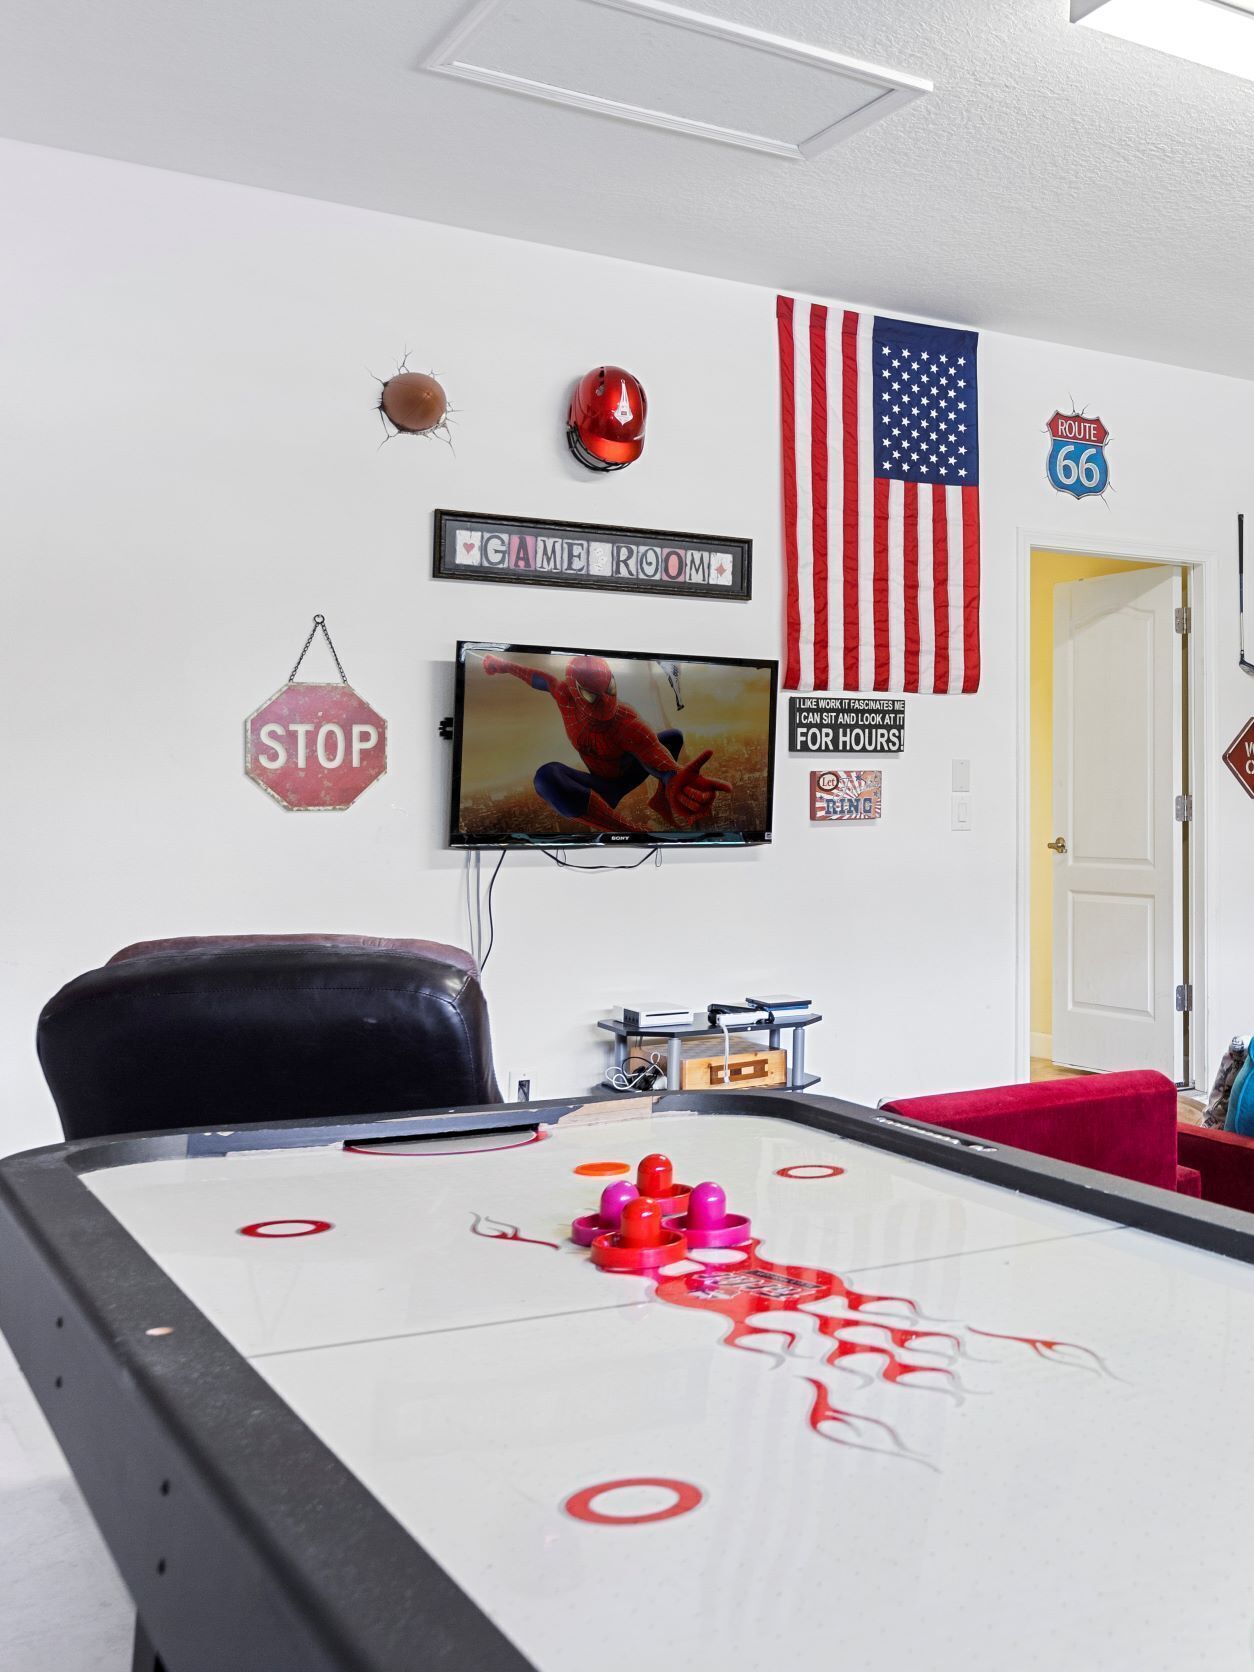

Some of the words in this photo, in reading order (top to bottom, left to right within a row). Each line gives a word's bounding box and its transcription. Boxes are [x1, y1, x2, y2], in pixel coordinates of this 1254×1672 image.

[1058, 419, 1097, 440] ROUTE
[1057, 445, 1100, 488] 66
[483, 534, 586, 573] GAME
[614, 544, 707, 583] ROOM
[800, 699, 817, 708] LIKE
[818, 699, 841, 709] WORK
[842, 700, 849, 709] IT
[850, 700, 893, 710] FASCINATES
[894, 701, 904, 711] ME
[801, 712, 820, 724] CAN
[822, 713, 836, 724] SIT
[838, 713, 856, 724] AND
[859, 713, 884, 725] LOOK
[884, 714, 895, 725] AT
[897, 714, 904, 725] IT
[258, 722, 379, 769] STOP
[796, 727, 833, 750] FOR
[839, 728, 904, 751] HOURS!
[822, 777, 835, 787] Let
[825, 797, 872, 815] RING
